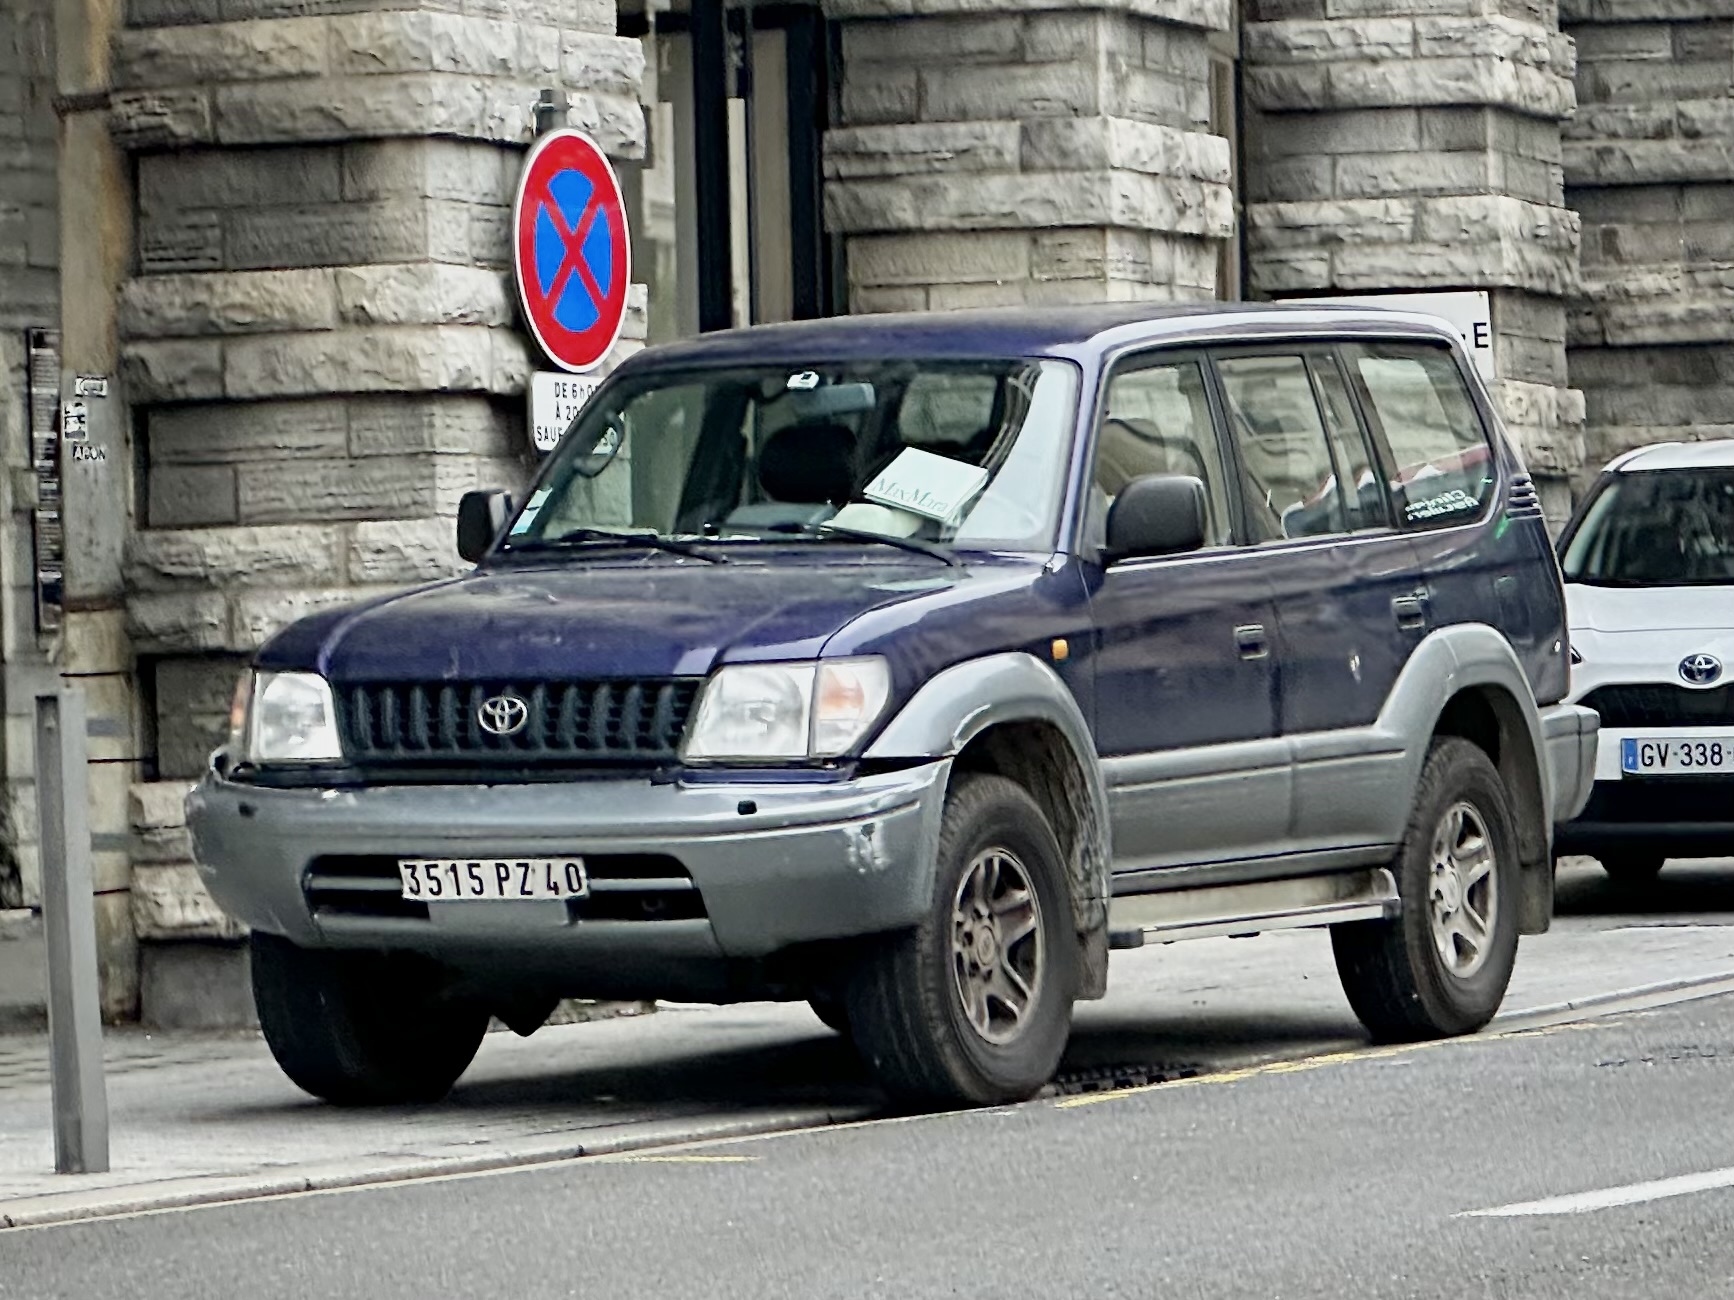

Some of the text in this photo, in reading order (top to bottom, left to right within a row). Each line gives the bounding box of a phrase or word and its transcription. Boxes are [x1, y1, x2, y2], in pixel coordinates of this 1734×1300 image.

[1461, 322, 1489, 348] E
[554, 382, 568, 399] DE
[1641, 743, 1734, 767] GV-338-
[404, 862, 582, 896] 3515 PZ 40
